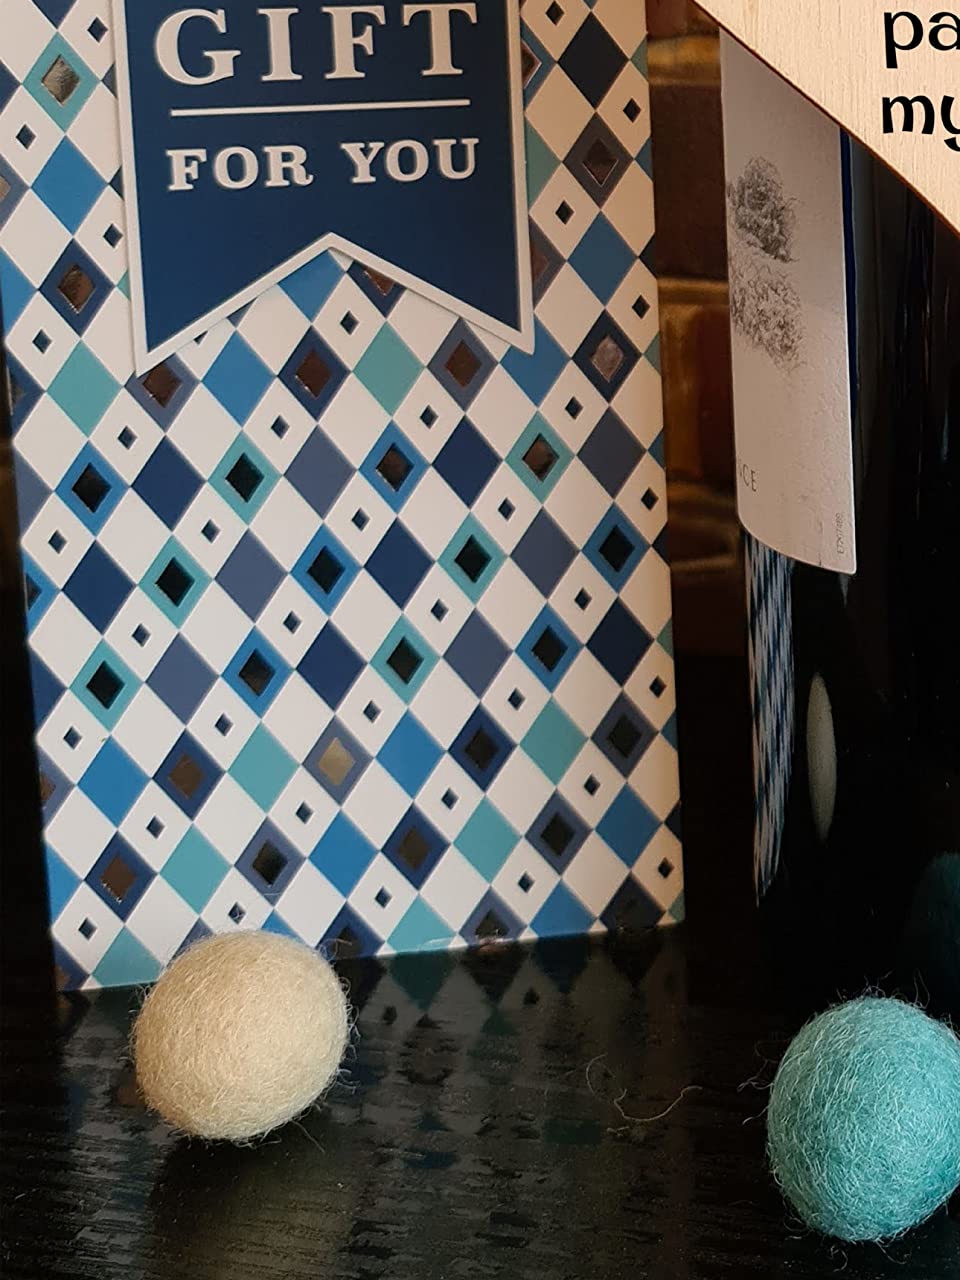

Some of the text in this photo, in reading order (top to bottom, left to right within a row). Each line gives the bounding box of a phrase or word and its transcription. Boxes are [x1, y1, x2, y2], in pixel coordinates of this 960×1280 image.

[154, 2, 478, 85] GIFT
[166, 138, 479, 191] FOR YOU
